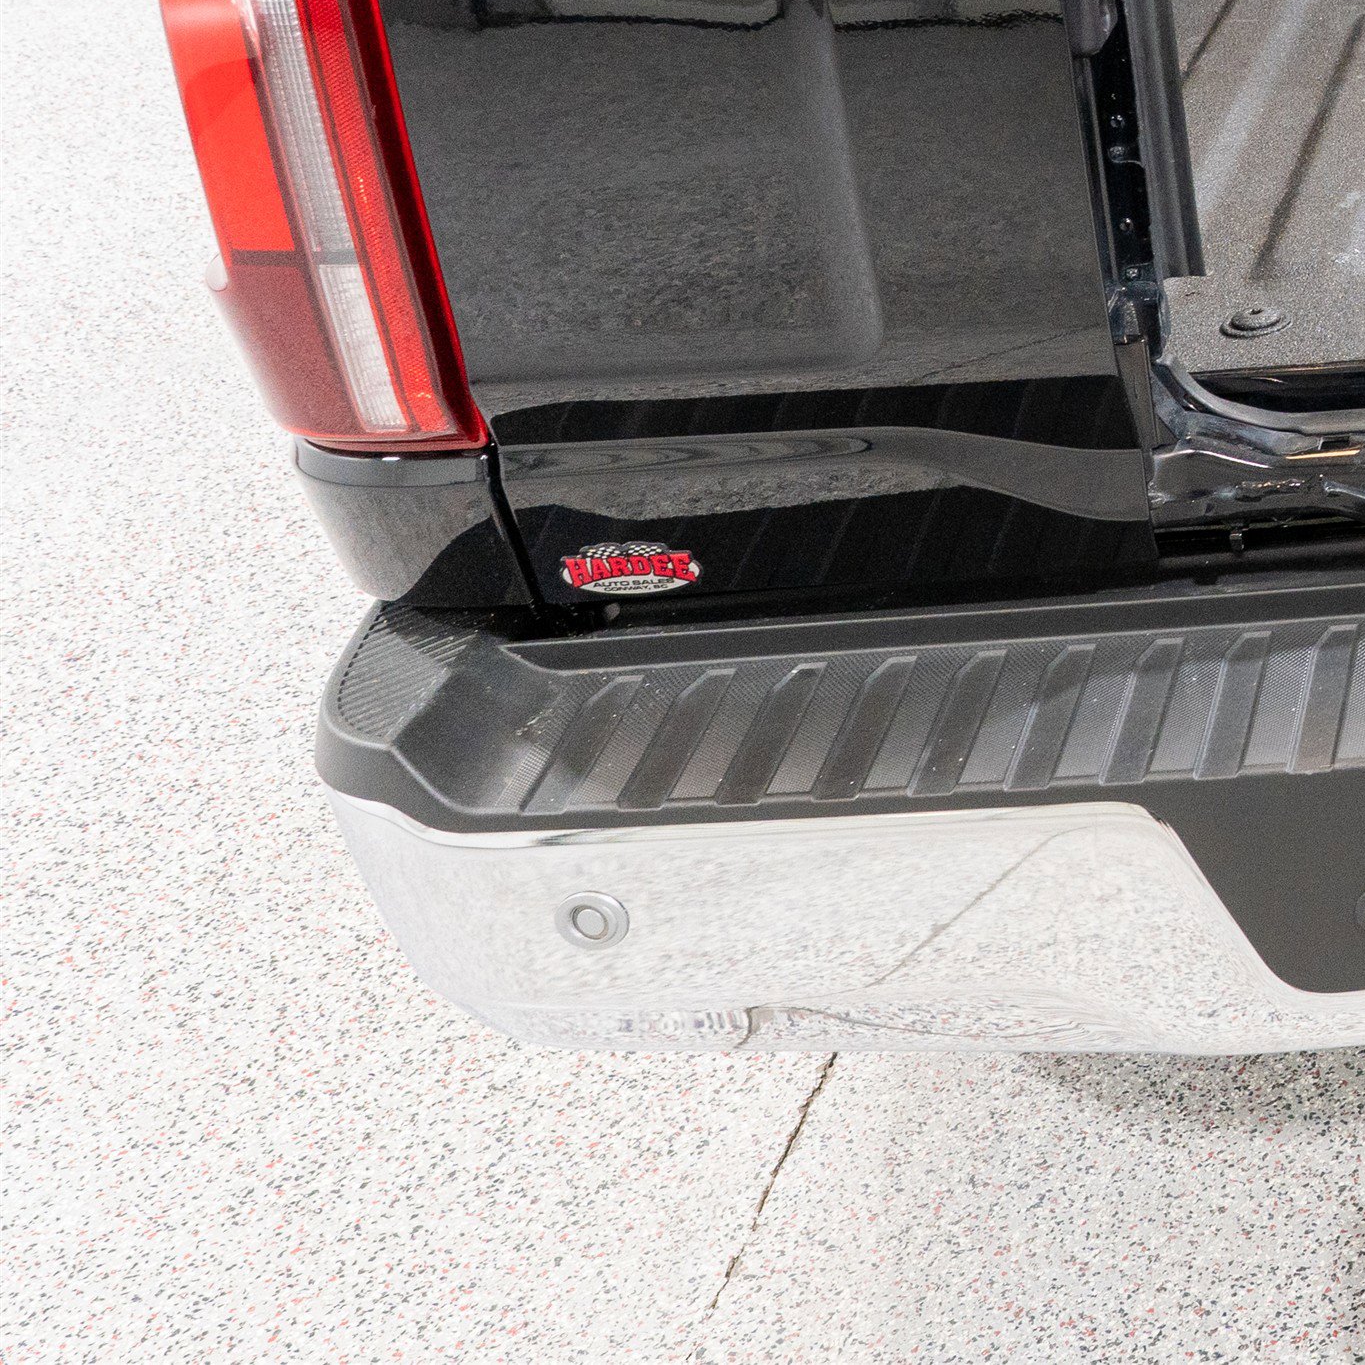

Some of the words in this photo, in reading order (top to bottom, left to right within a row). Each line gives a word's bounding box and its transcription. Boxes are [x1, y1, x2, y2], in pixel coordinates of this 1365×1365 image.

[565, 553, 697, 588] HARDEE
[594, 580, 630, 588] AUTO
[632, 577, 674, 586] SALES
